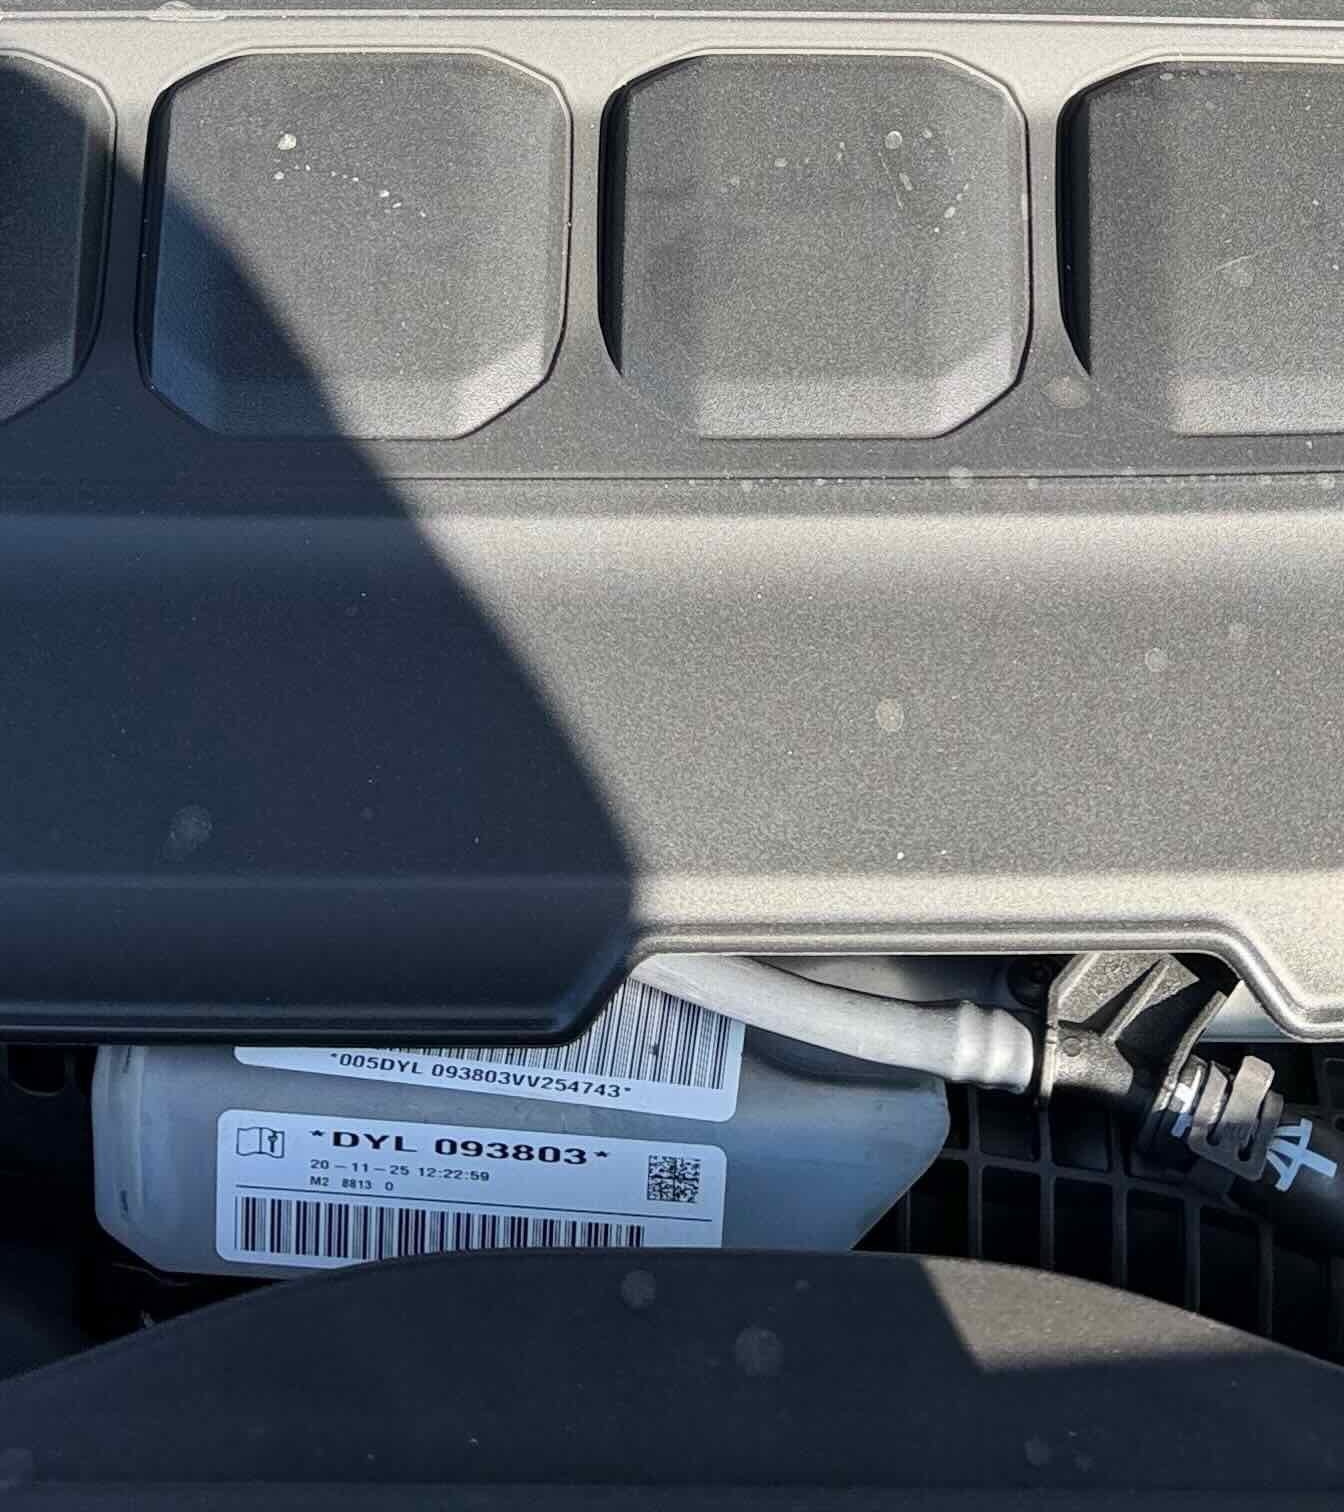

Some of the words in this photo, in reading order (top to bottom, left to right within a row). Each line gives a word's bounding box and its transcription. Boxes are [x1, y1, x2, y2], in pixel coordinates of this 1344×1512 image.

[310, 1159, 330, 1170] 20
[352, 1162, 369, 1173] 11
[390, 1165, 410, 1177] 25
[418, 1167, 490, 1182] 12:22:59
[310, 1176, 330, 1187] M2
[341, 1178, 373, 1190] 8813
